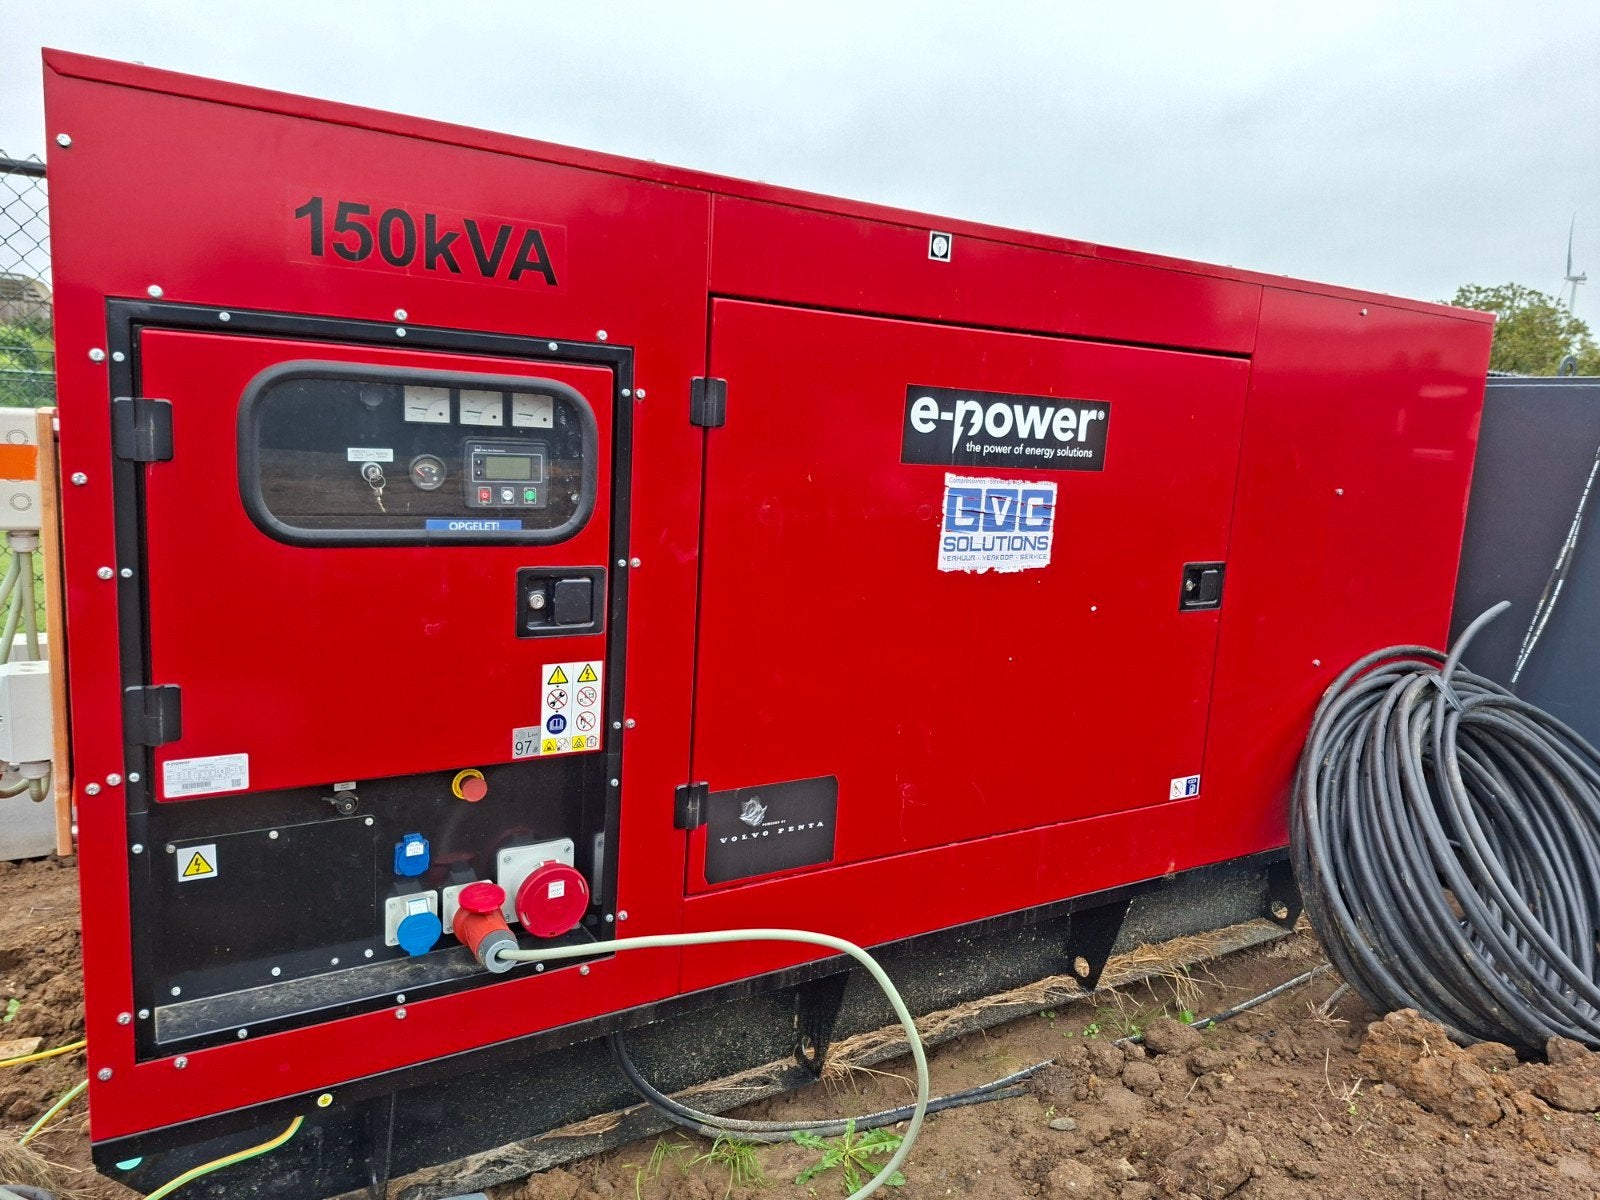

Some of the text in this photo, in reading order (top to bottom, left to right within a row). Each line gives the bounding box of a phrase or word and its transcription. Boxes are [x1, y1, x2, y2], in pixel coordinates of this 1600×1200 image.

[295, 196, 559, 287] 150kVA
[965, 442, 1093, 459] the power of energy solutions
[449, 521, 501, 532] OPGELET!
[943, 536, 1049, 552] SOLUTIONS
[515, 740, 533, 756] 97
[720, 821, 825, 844] VOLVO PENTA
